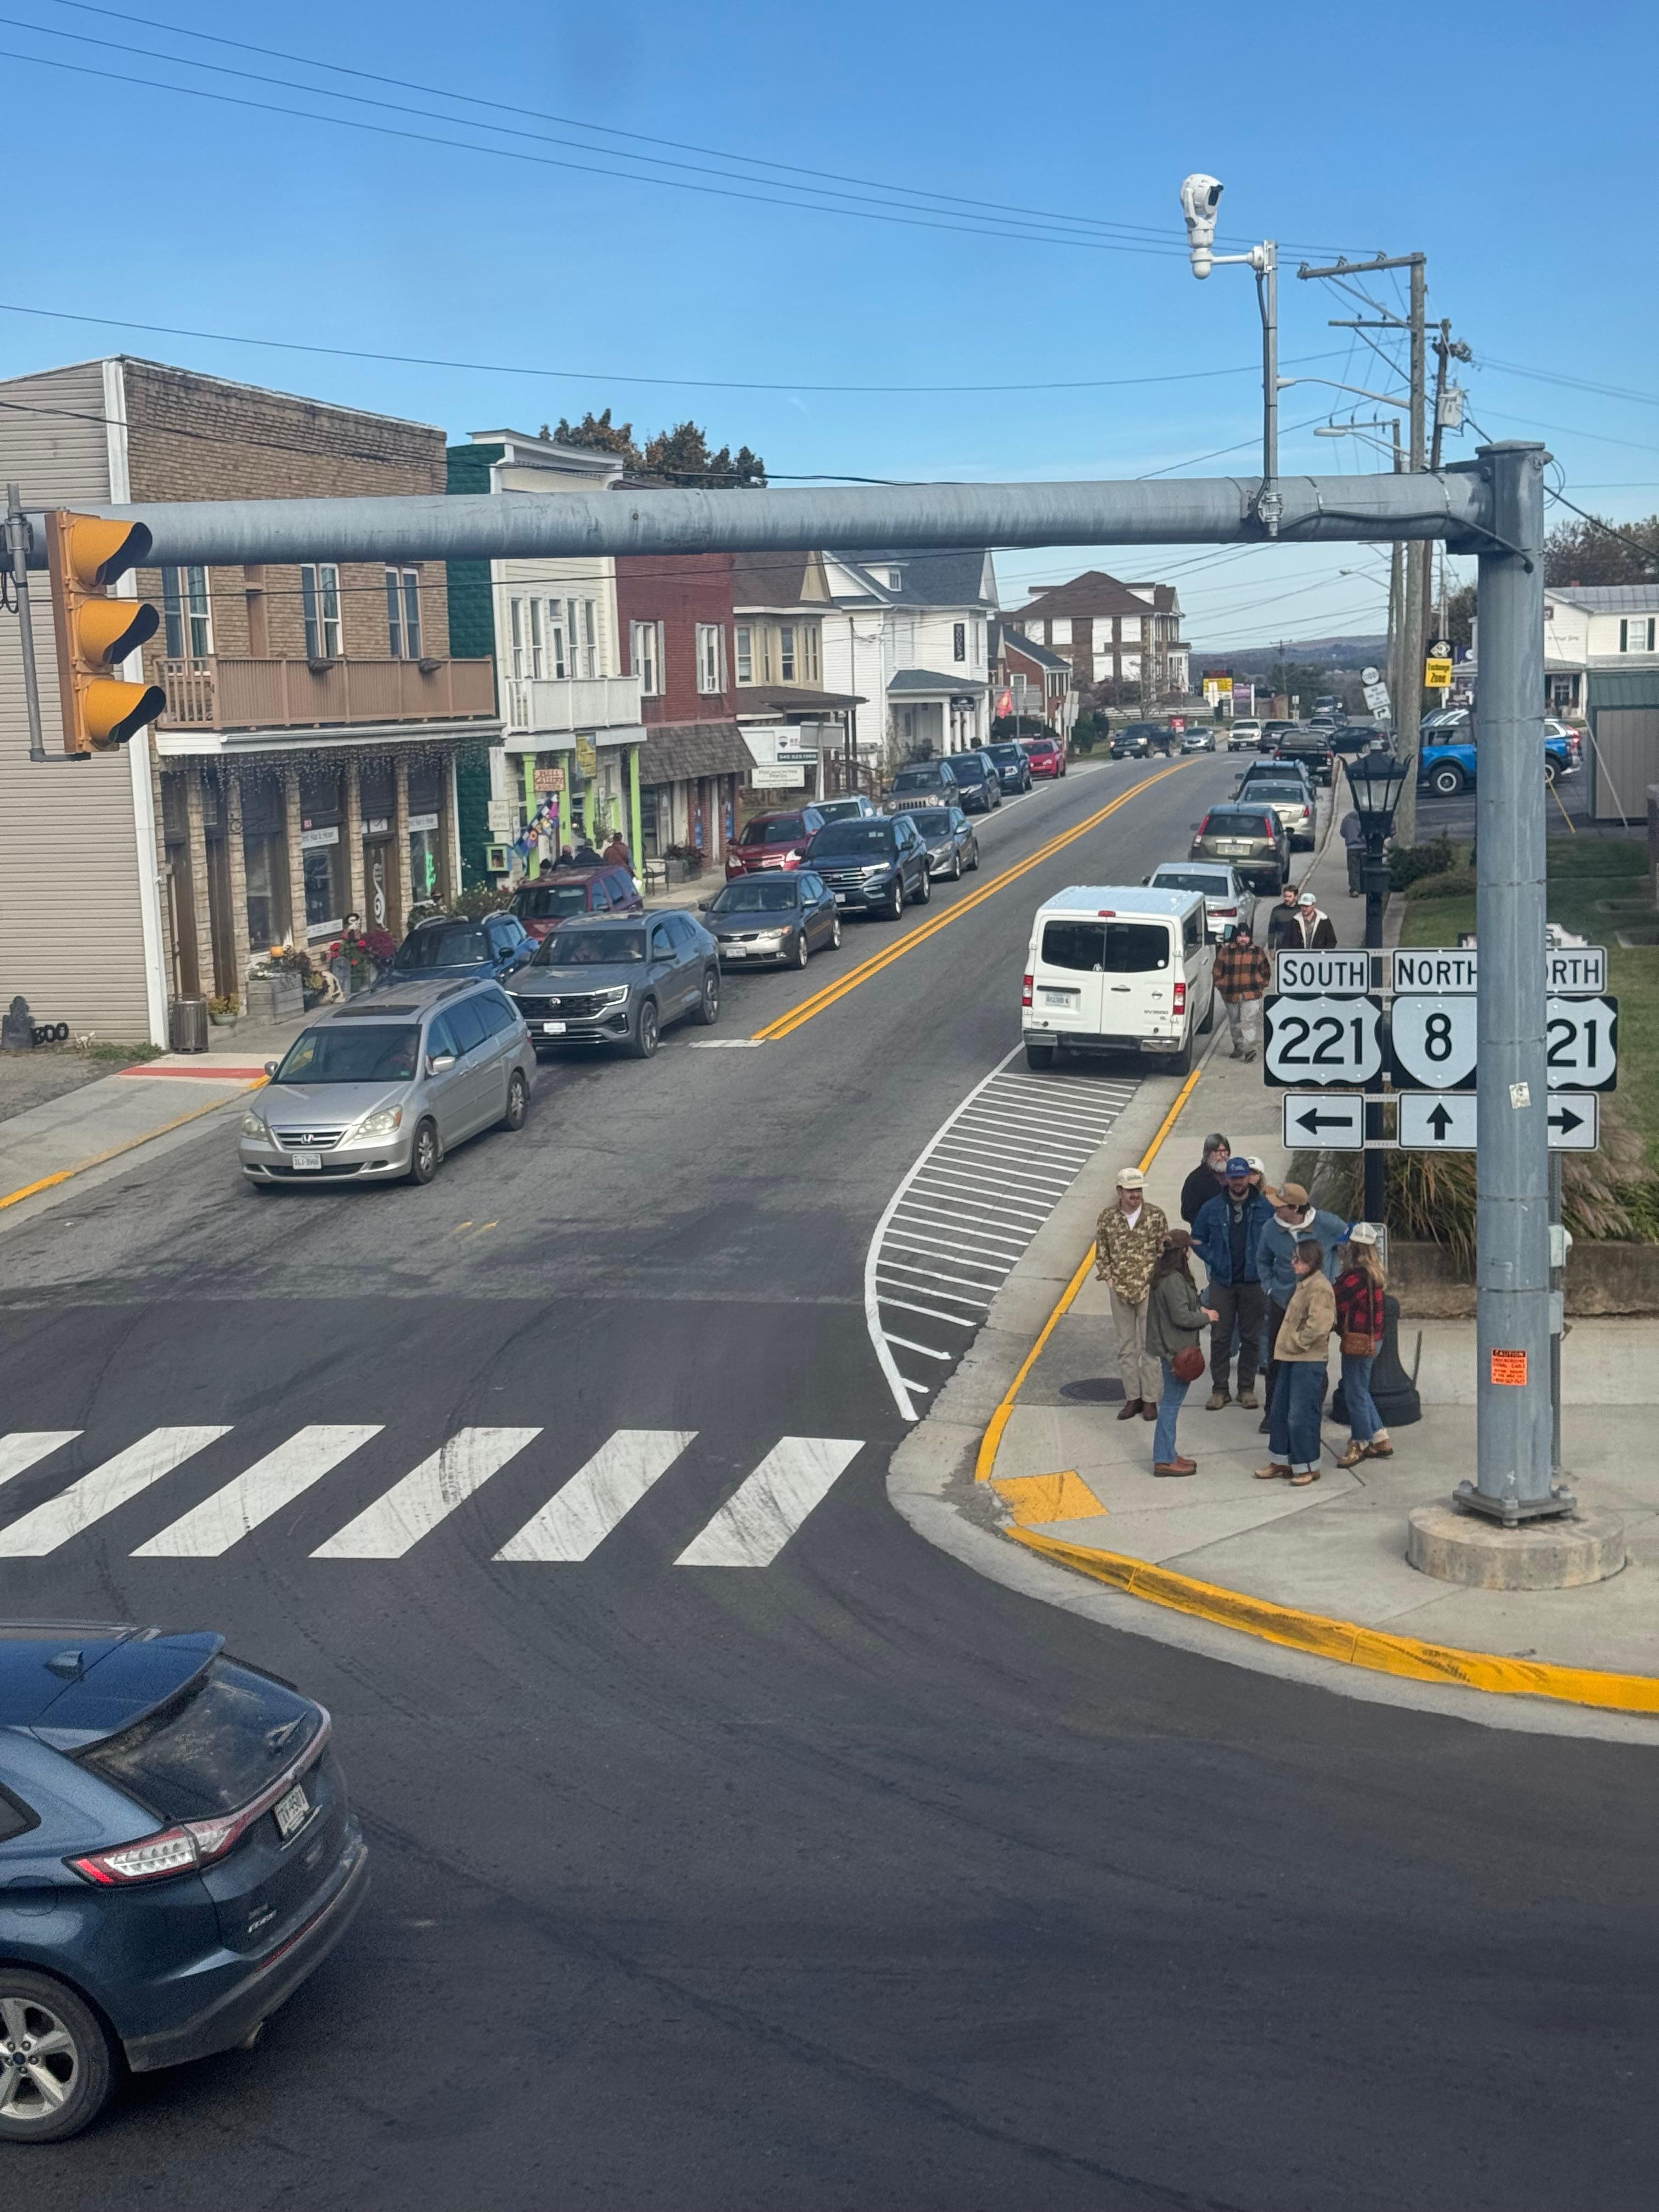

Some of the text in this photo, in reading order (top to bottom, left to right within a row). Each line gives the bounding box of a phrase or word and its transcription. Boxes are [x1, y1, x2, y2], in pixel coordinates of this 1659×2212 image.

[1430, 672, 1446, 683] Zone
[1282, 959, 1364, 987] SOUTH
[1547, 959, 1599, 984] RTH
[1278, 1017, 1363, 1065] 221
[1424, 1013, 1452, 1062] 8
[1547, 1019, 1597, 1068] 21
